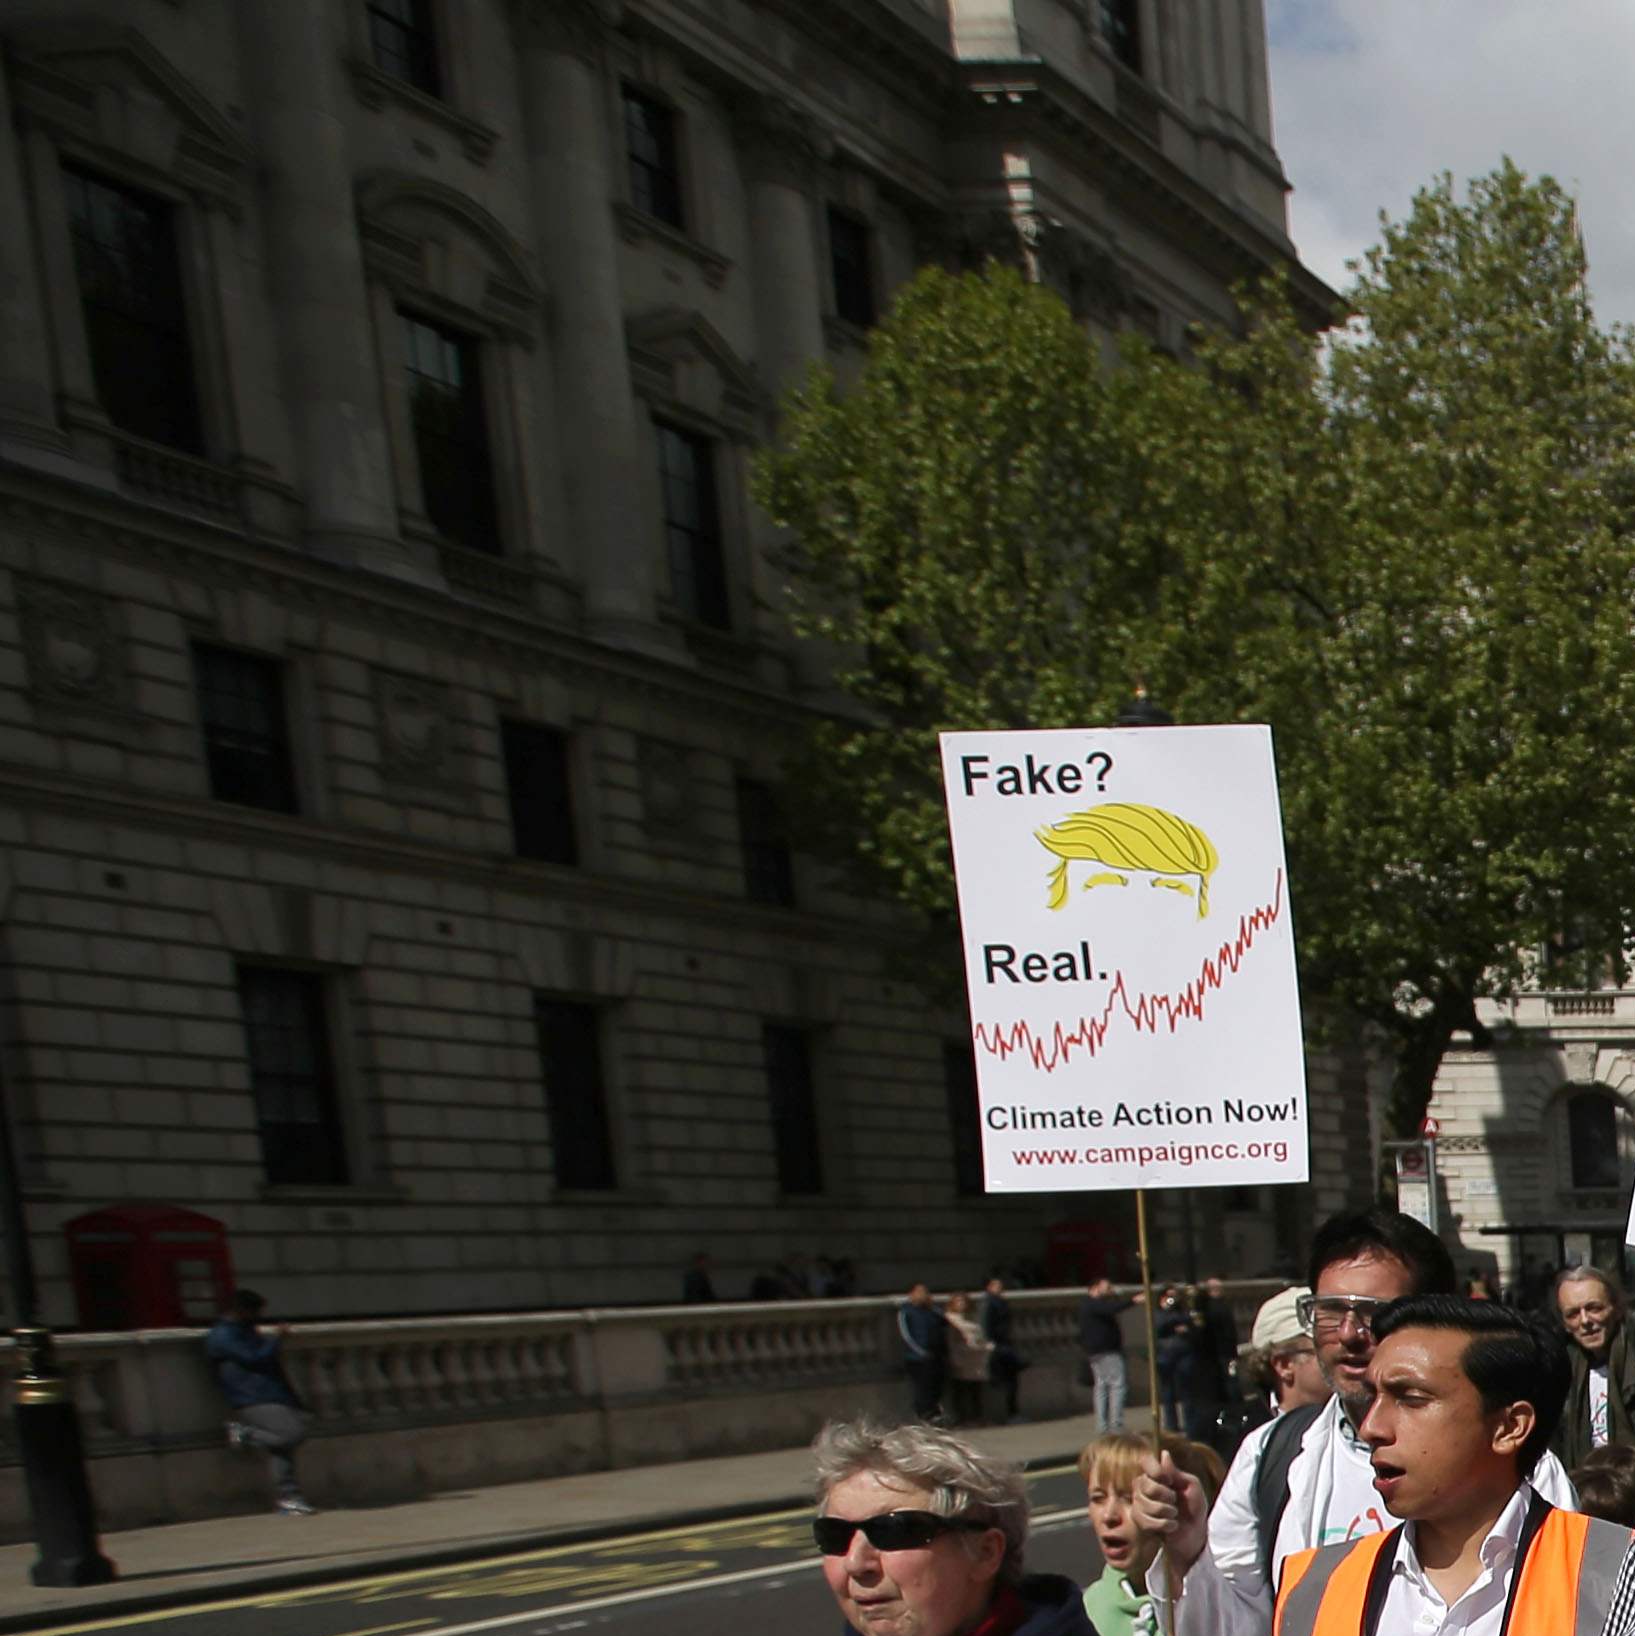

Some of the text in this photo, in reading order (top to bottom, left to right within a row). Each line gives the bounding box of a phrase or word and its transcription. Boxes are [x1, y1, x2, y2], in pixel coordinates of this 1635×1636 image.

[960, 751, 1114, 796] Fake?
[983, 941, 1109, 984] Real.
[987, 1097, 1299, 1131] Climate Action Now!
[1011, 1141, 1289, 1168] www.campaigncc.org
